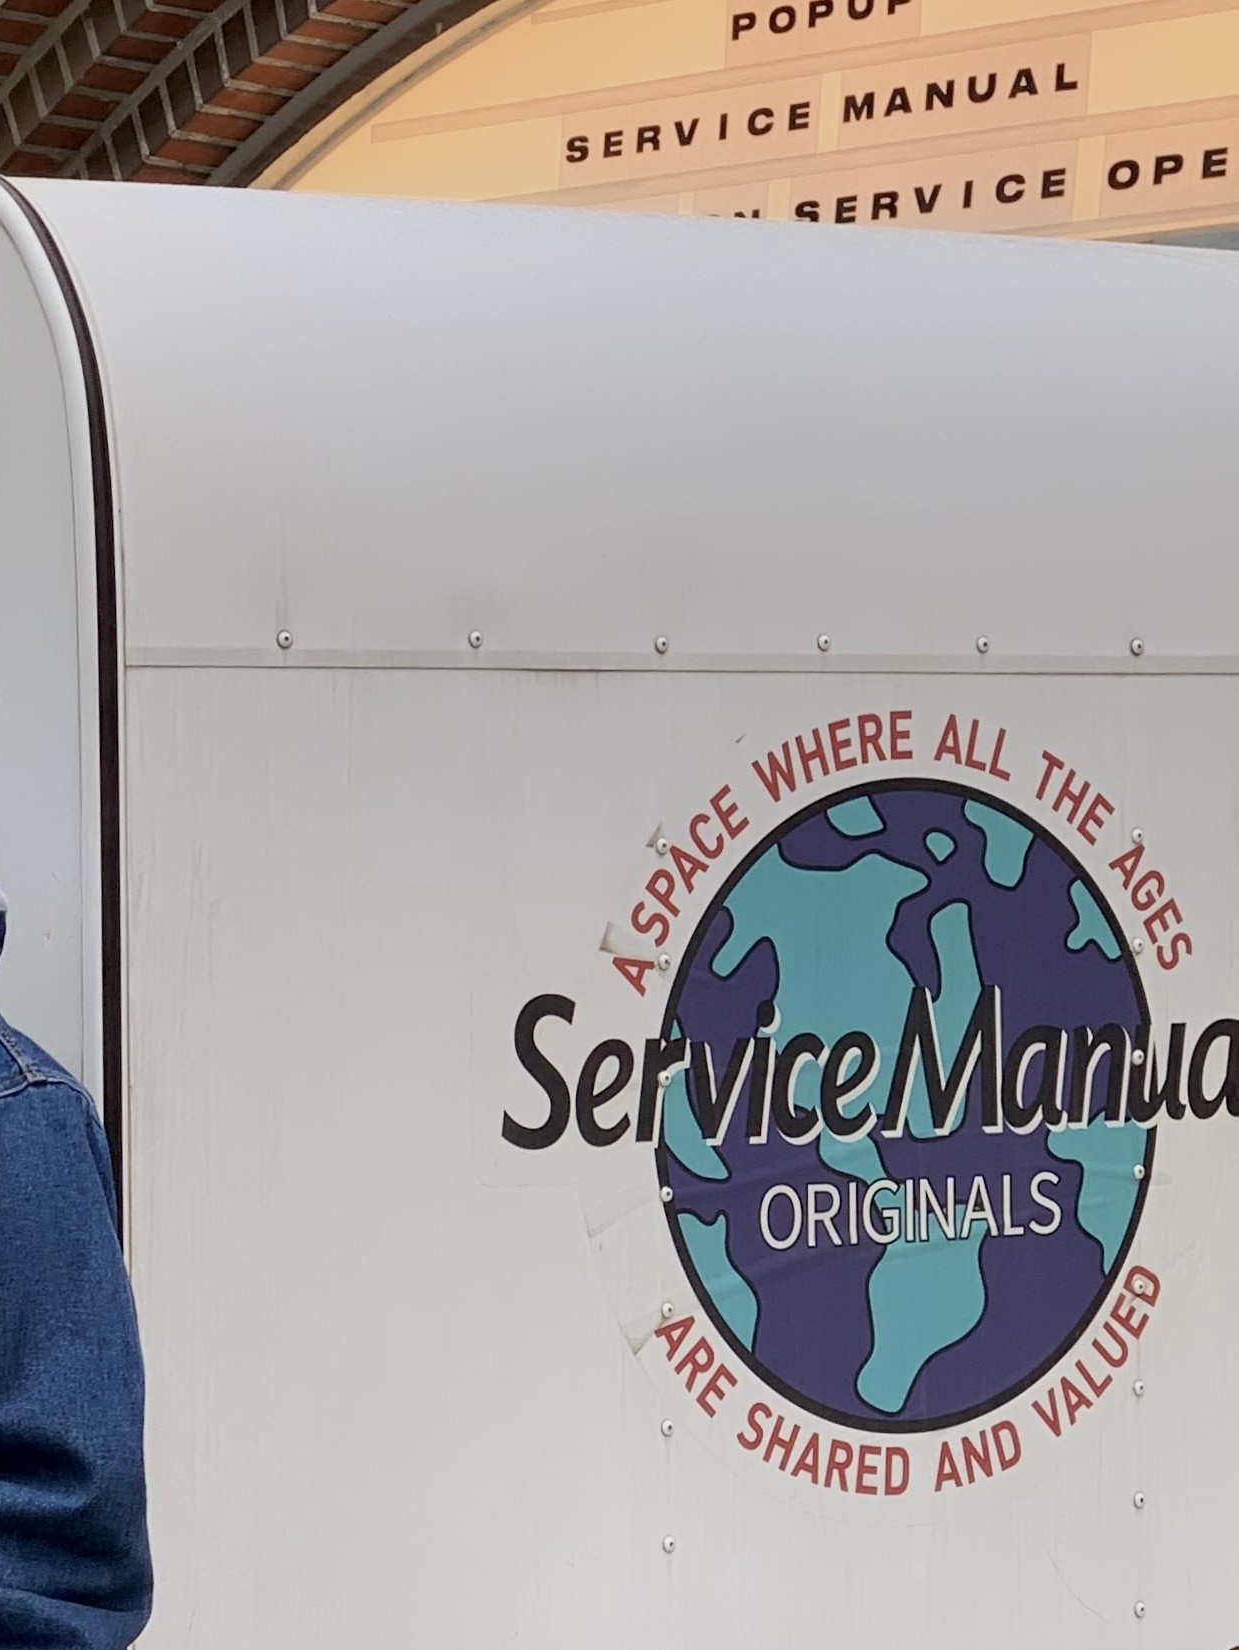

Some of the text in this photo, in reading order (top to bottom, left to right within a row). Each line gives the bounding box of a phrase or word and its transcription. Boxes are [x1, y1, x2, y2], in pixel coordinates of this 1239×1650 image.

[566, 64, 1078, 163] SERVICE MANUAL
[795, 147, 1228, 224] SERVICE OPE
[613, 710, 1193, 995] A SPACE WHERE ALL THE AGES
[760, 1171, 1062, 1250] ORIGINALS
[655, 1265, 1160, 1496] ARE SHARED AND VALUED
